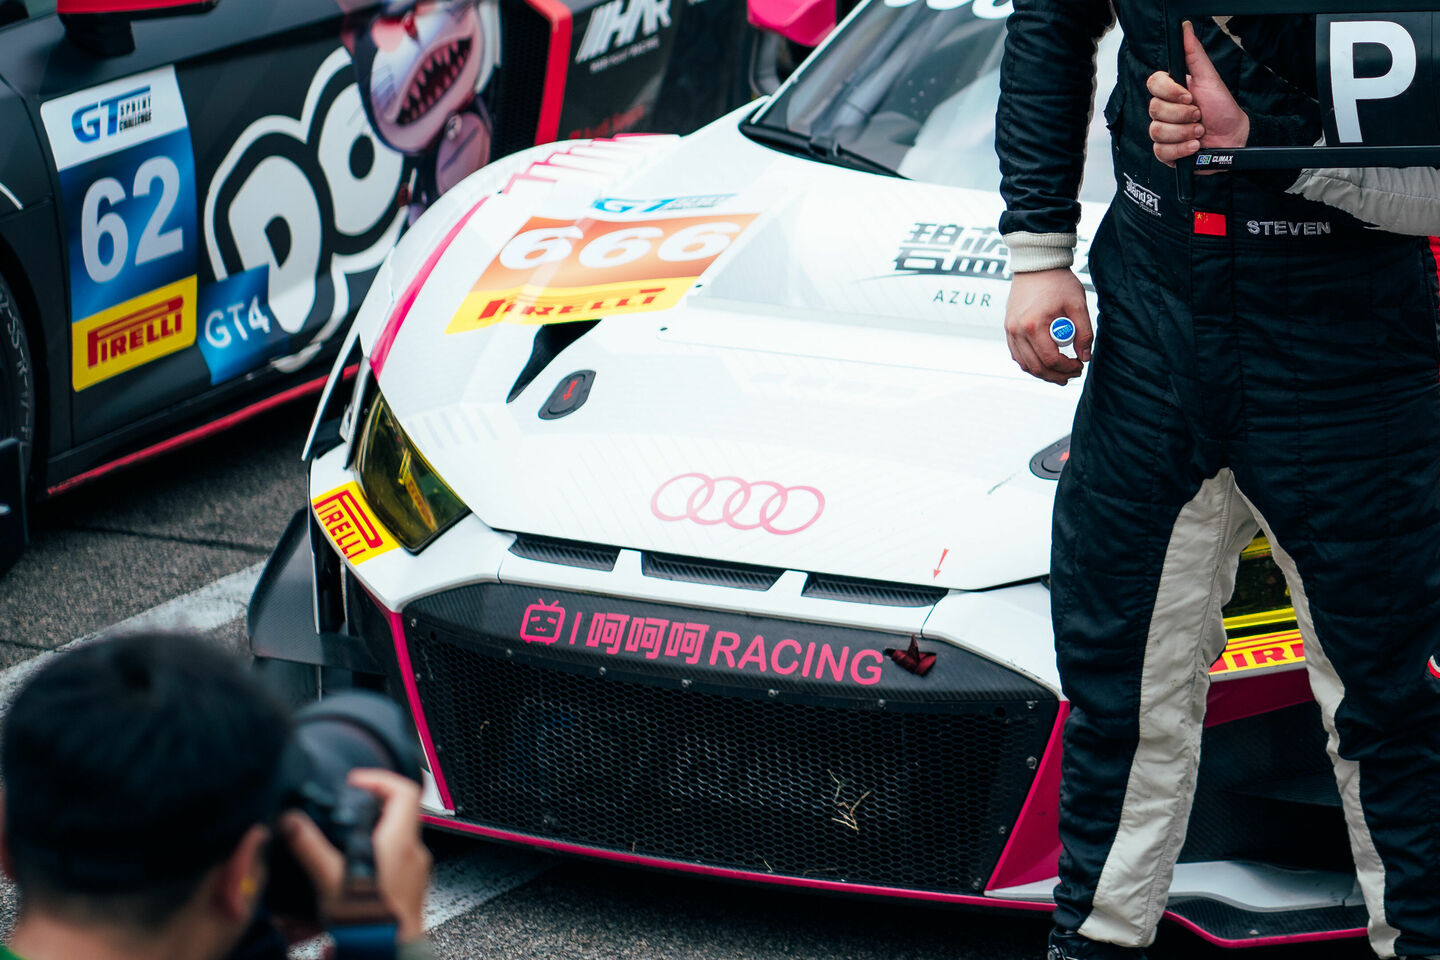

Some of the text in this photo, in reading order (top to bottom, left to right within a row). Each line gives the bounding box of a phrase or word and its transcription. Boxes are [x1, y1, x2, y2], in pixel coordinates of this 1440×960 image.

[71, 85, 151, 144] GT
[81, 156, 183, 283] 62
[500, 222, 741, 270] 666
[1247, 220, 1332, 237] STEVEN
[204, 296, 271, 349] GT4
[478, 288, 666, 320] PIRELLI
[933, 290, 992, 307] AZUR
[87, 294, 184, 369] PIRELLI
[313, 489, 384, 560] PIRELLI
[586, 612, 884, 686] 呵呵呵 RACING
